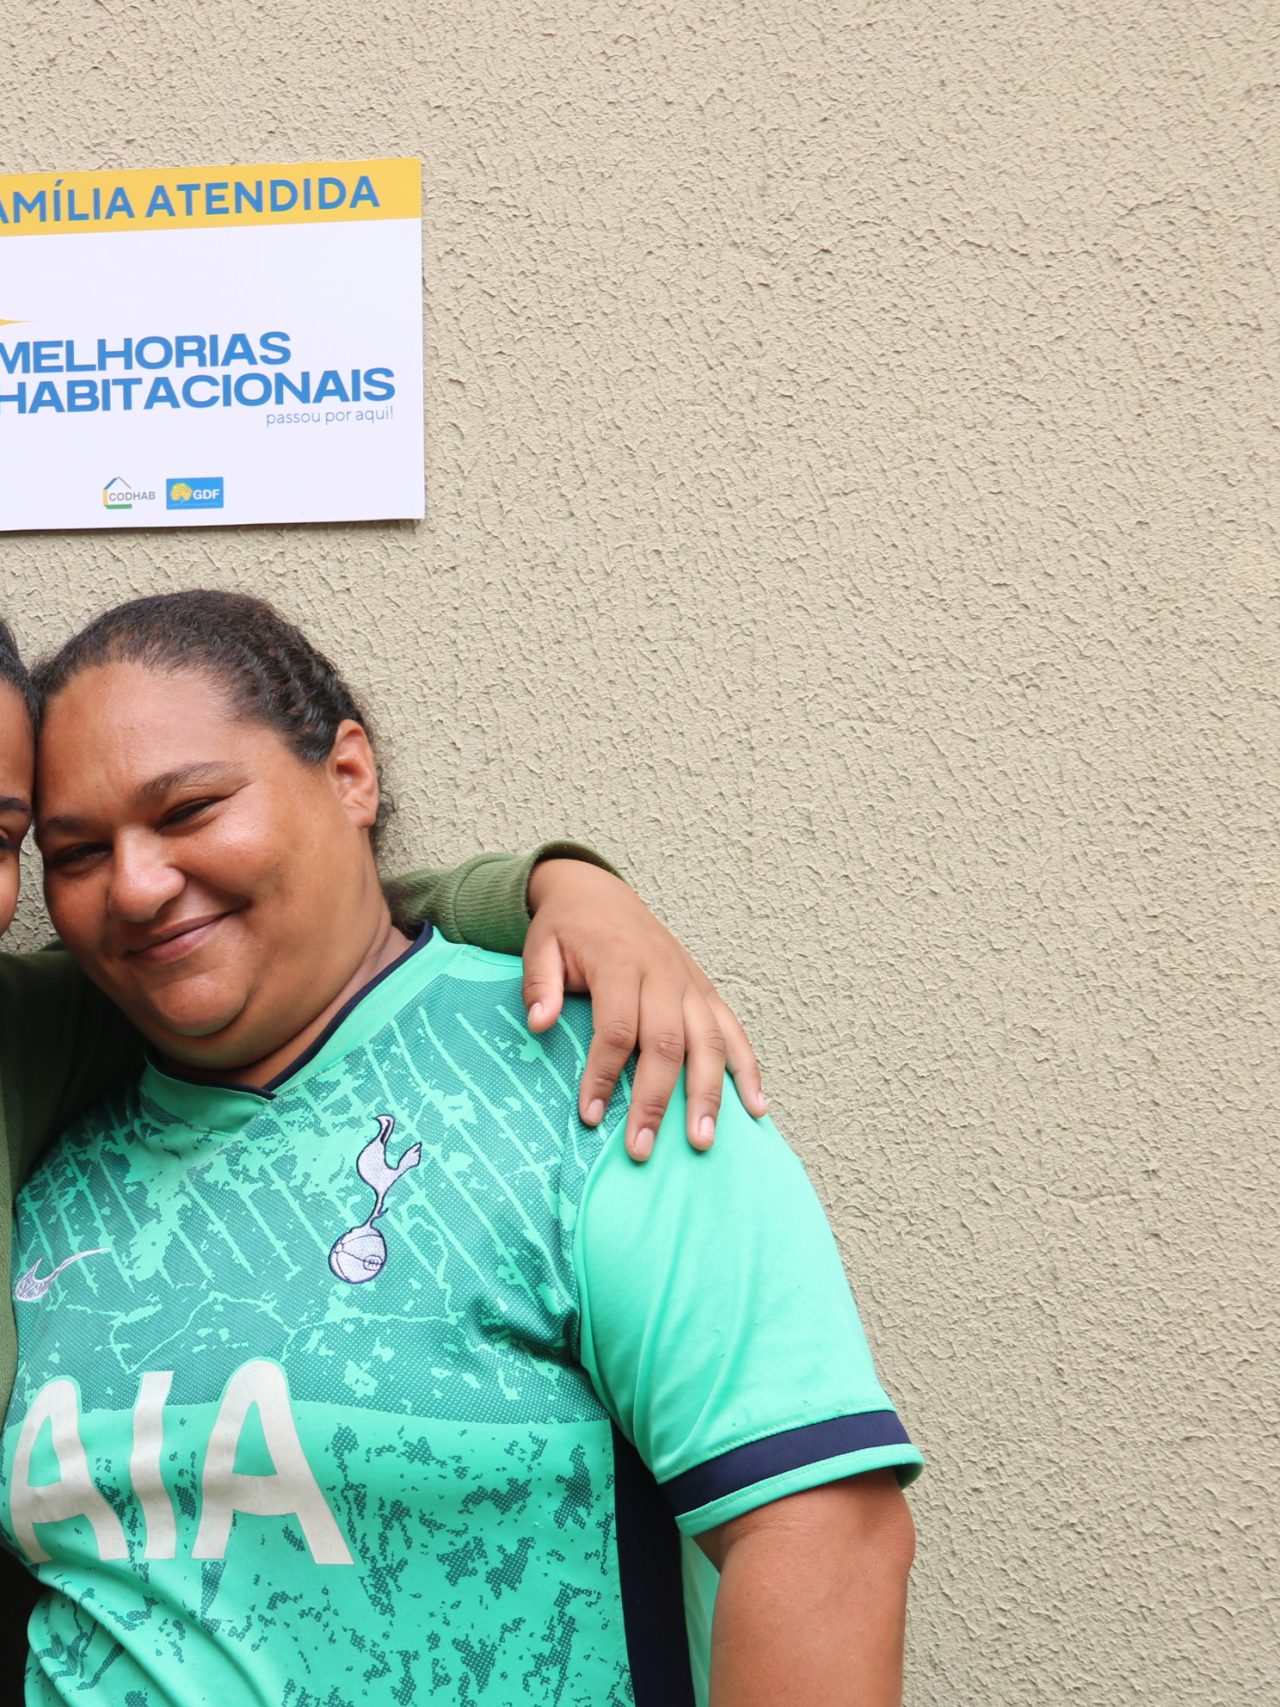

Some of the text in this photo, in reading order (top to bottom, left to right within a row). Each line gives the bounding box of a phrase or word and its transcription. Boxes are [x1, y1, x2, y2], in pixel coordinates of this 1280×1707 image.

[145, 175, 381, 218] ATENDIDA
[266, 406, 394, 428] passou por aqui!
[109, 491, 156, 501] CODHAB
[192, 489, 220, 500] GDF
[10, 1359, 354, 1564] AIA
